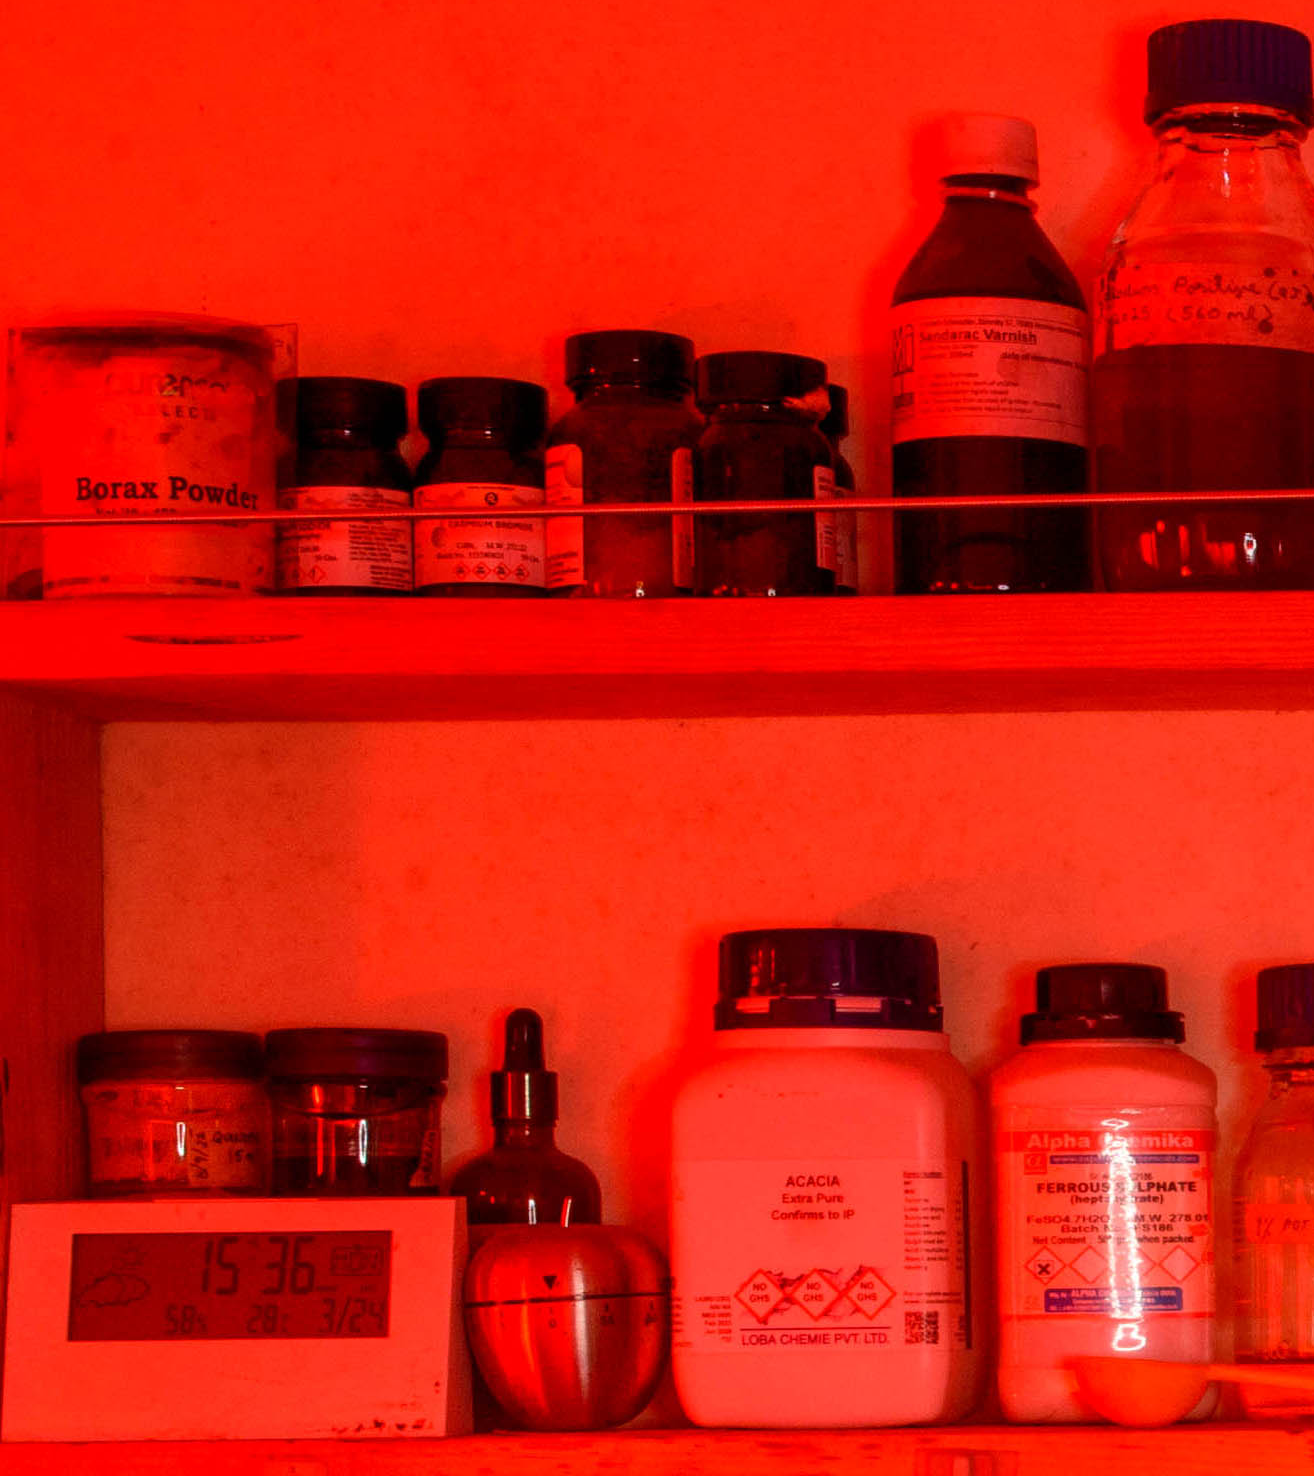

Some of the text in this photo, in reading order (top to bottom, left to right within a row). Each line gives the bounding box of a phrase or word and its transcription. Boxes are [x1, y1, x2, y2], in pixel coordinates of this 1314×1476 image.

[983, 329, 1038, 344] Varnish
[75, 475, 259, 510] Borax Powder
[1027, 1133, 1090, 1152] Alpha
[785, 1175, 841, 1188] ACACIA
[1036, 1181, 1109, 1194] FERROUS
[781, 1193, 845, 1204] Extra Pure
[771, 1209, 825, 1221] Confirms
[827, 1210, 840, 1221] to
[752, 1282, 767, 1292] NO
[806, 1282, 820, 1291] NO
[860, 1281, 874, 1291] NO
[741, 1333, 777, 1347] LOBA
[779, 1333, 830, 1346] CHEMIE
